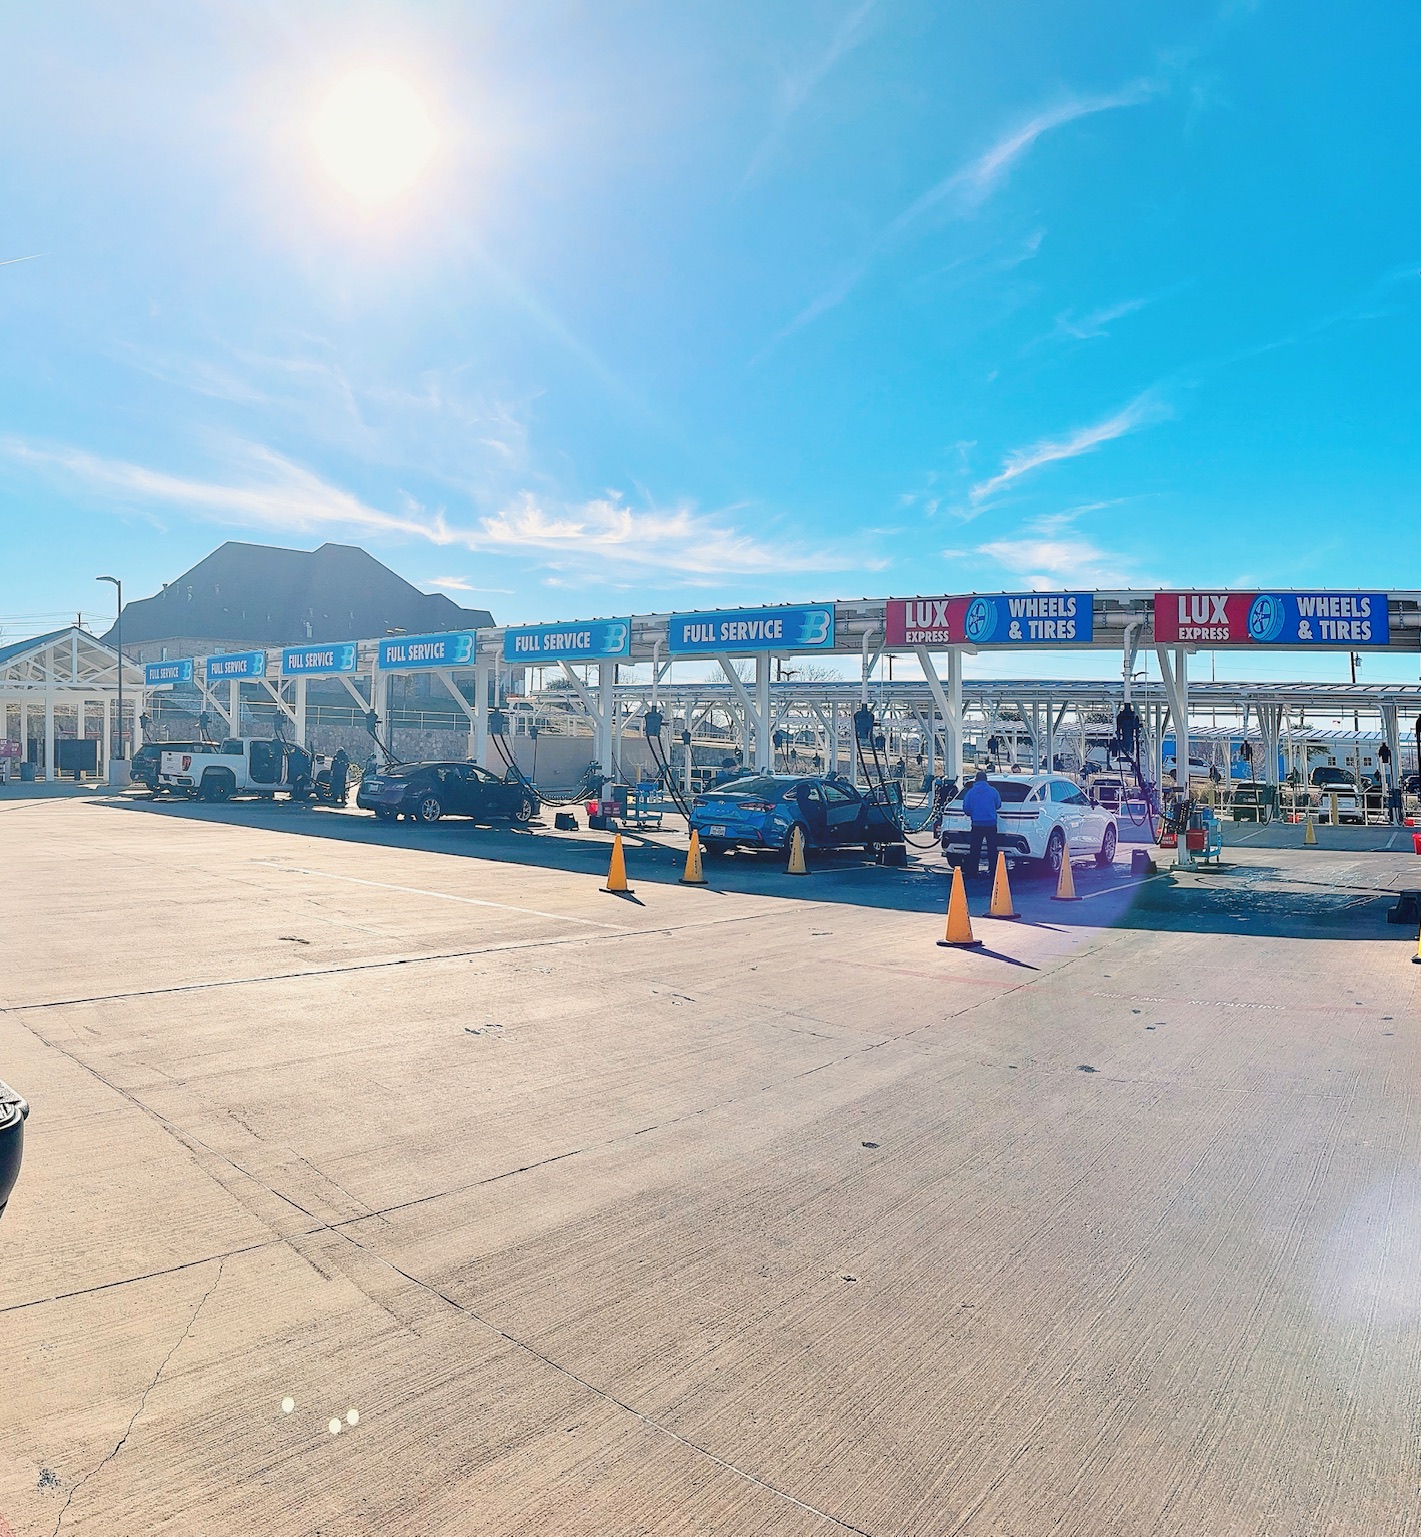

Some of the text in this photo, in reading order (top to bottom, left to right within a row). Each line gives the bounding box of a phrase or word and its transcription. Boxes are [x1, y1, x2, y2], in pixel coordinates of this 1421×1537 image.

[905, 600, 949, 628] LUX
[1008, 597, 1076, 618] WHEELS
[1178, 596, 1229, 624] LUX
[1297, 597, 1371, 618] WHEELS
[683, 619, 783, 643] FULL SERVICE
[905, 630, 949, 643] EXPRESS
[1008, 619, 1076, 640] & TIRES
[1178, 628, 1230, 640] EXPRESS
[1298, 620, 1372, 640] & TIRES
[515, 631, 591, 652] FULL SERVICE
[288, 652, 334, 669] FULL SERVICE
[386, 642, 445, 663] FULL SERVICE
[149, 666, 179, 680] FULL SERVICE
[211, 660, 247, 675] FULL SERVICE
